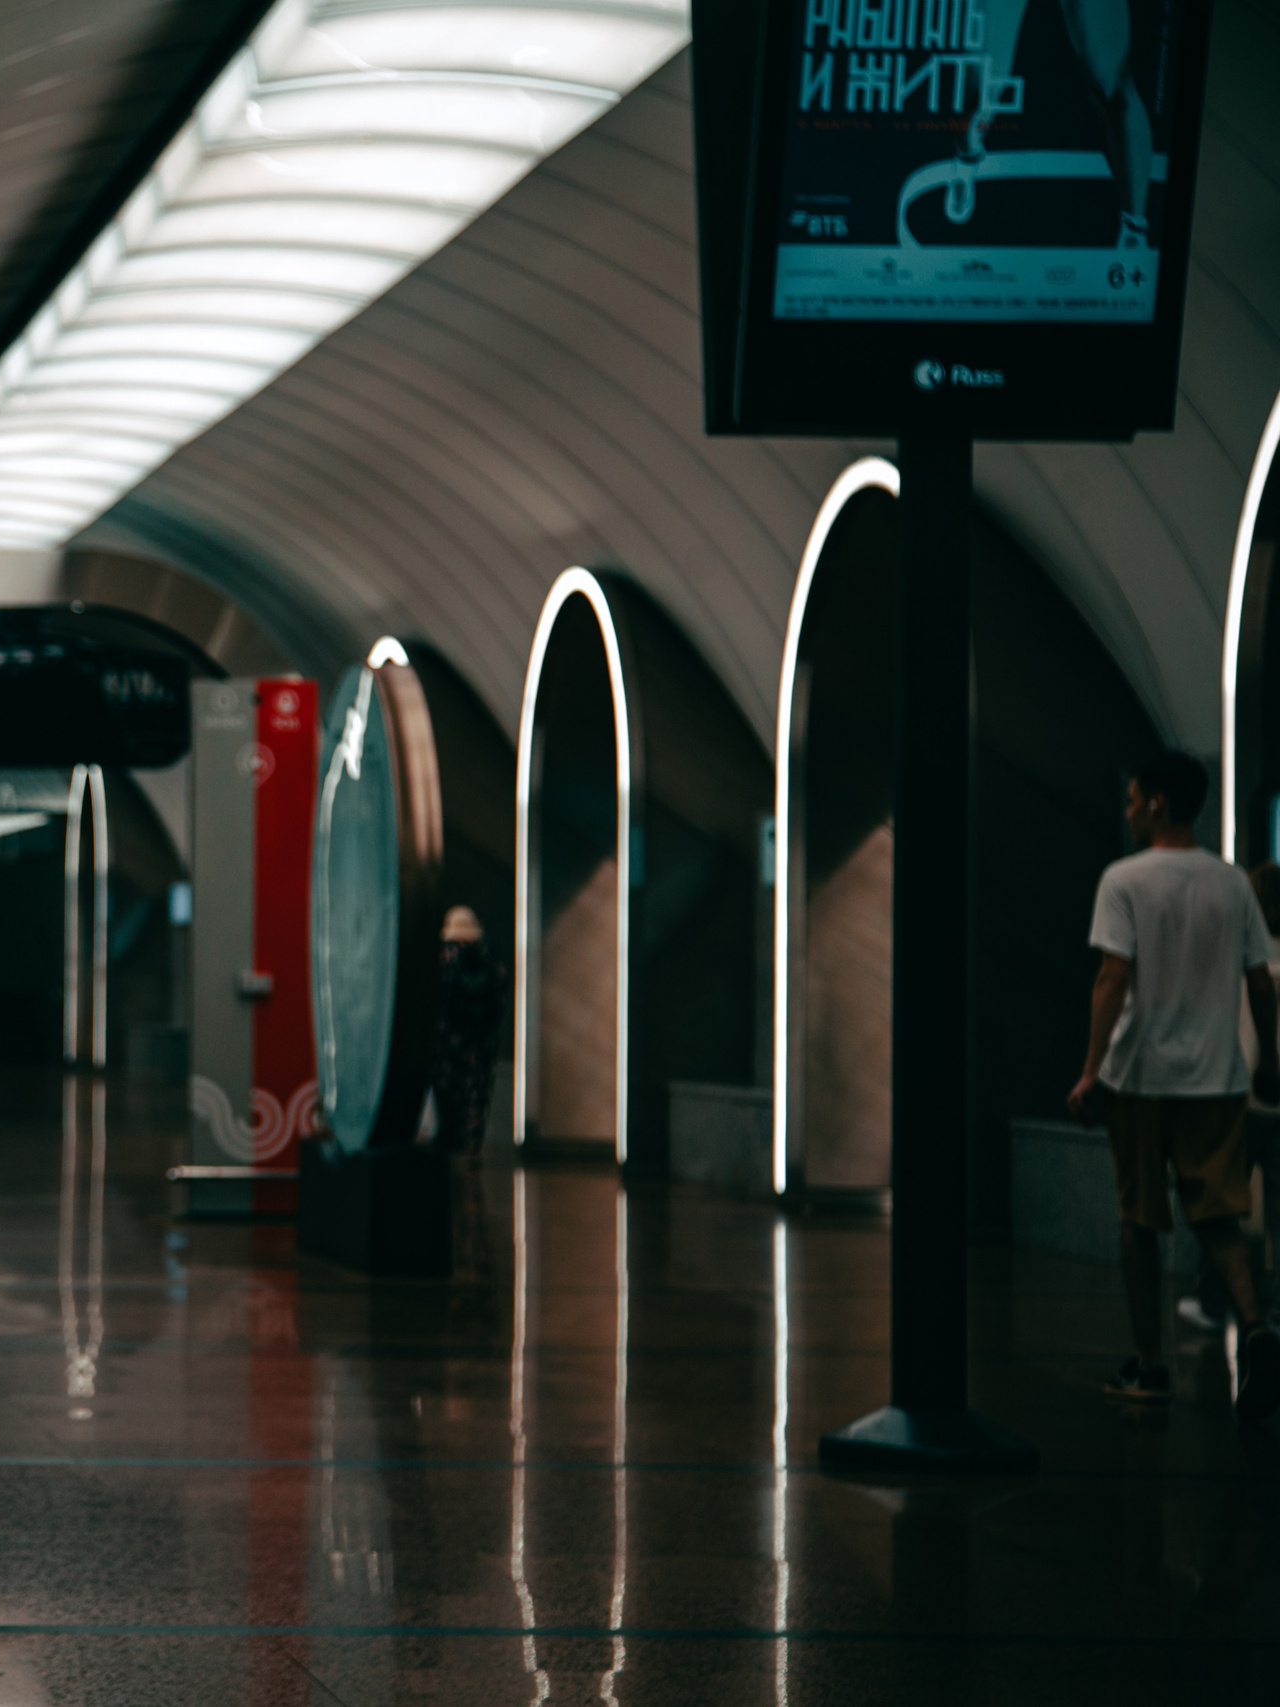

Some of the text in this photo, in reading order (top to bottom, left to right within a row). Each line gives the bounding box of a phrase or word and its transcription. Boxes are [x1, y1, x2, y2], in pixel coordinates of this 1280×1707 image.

[799, 51, 1026, 115] И ЖИТЬ
[1107, 261, 1148, 290] 6+
